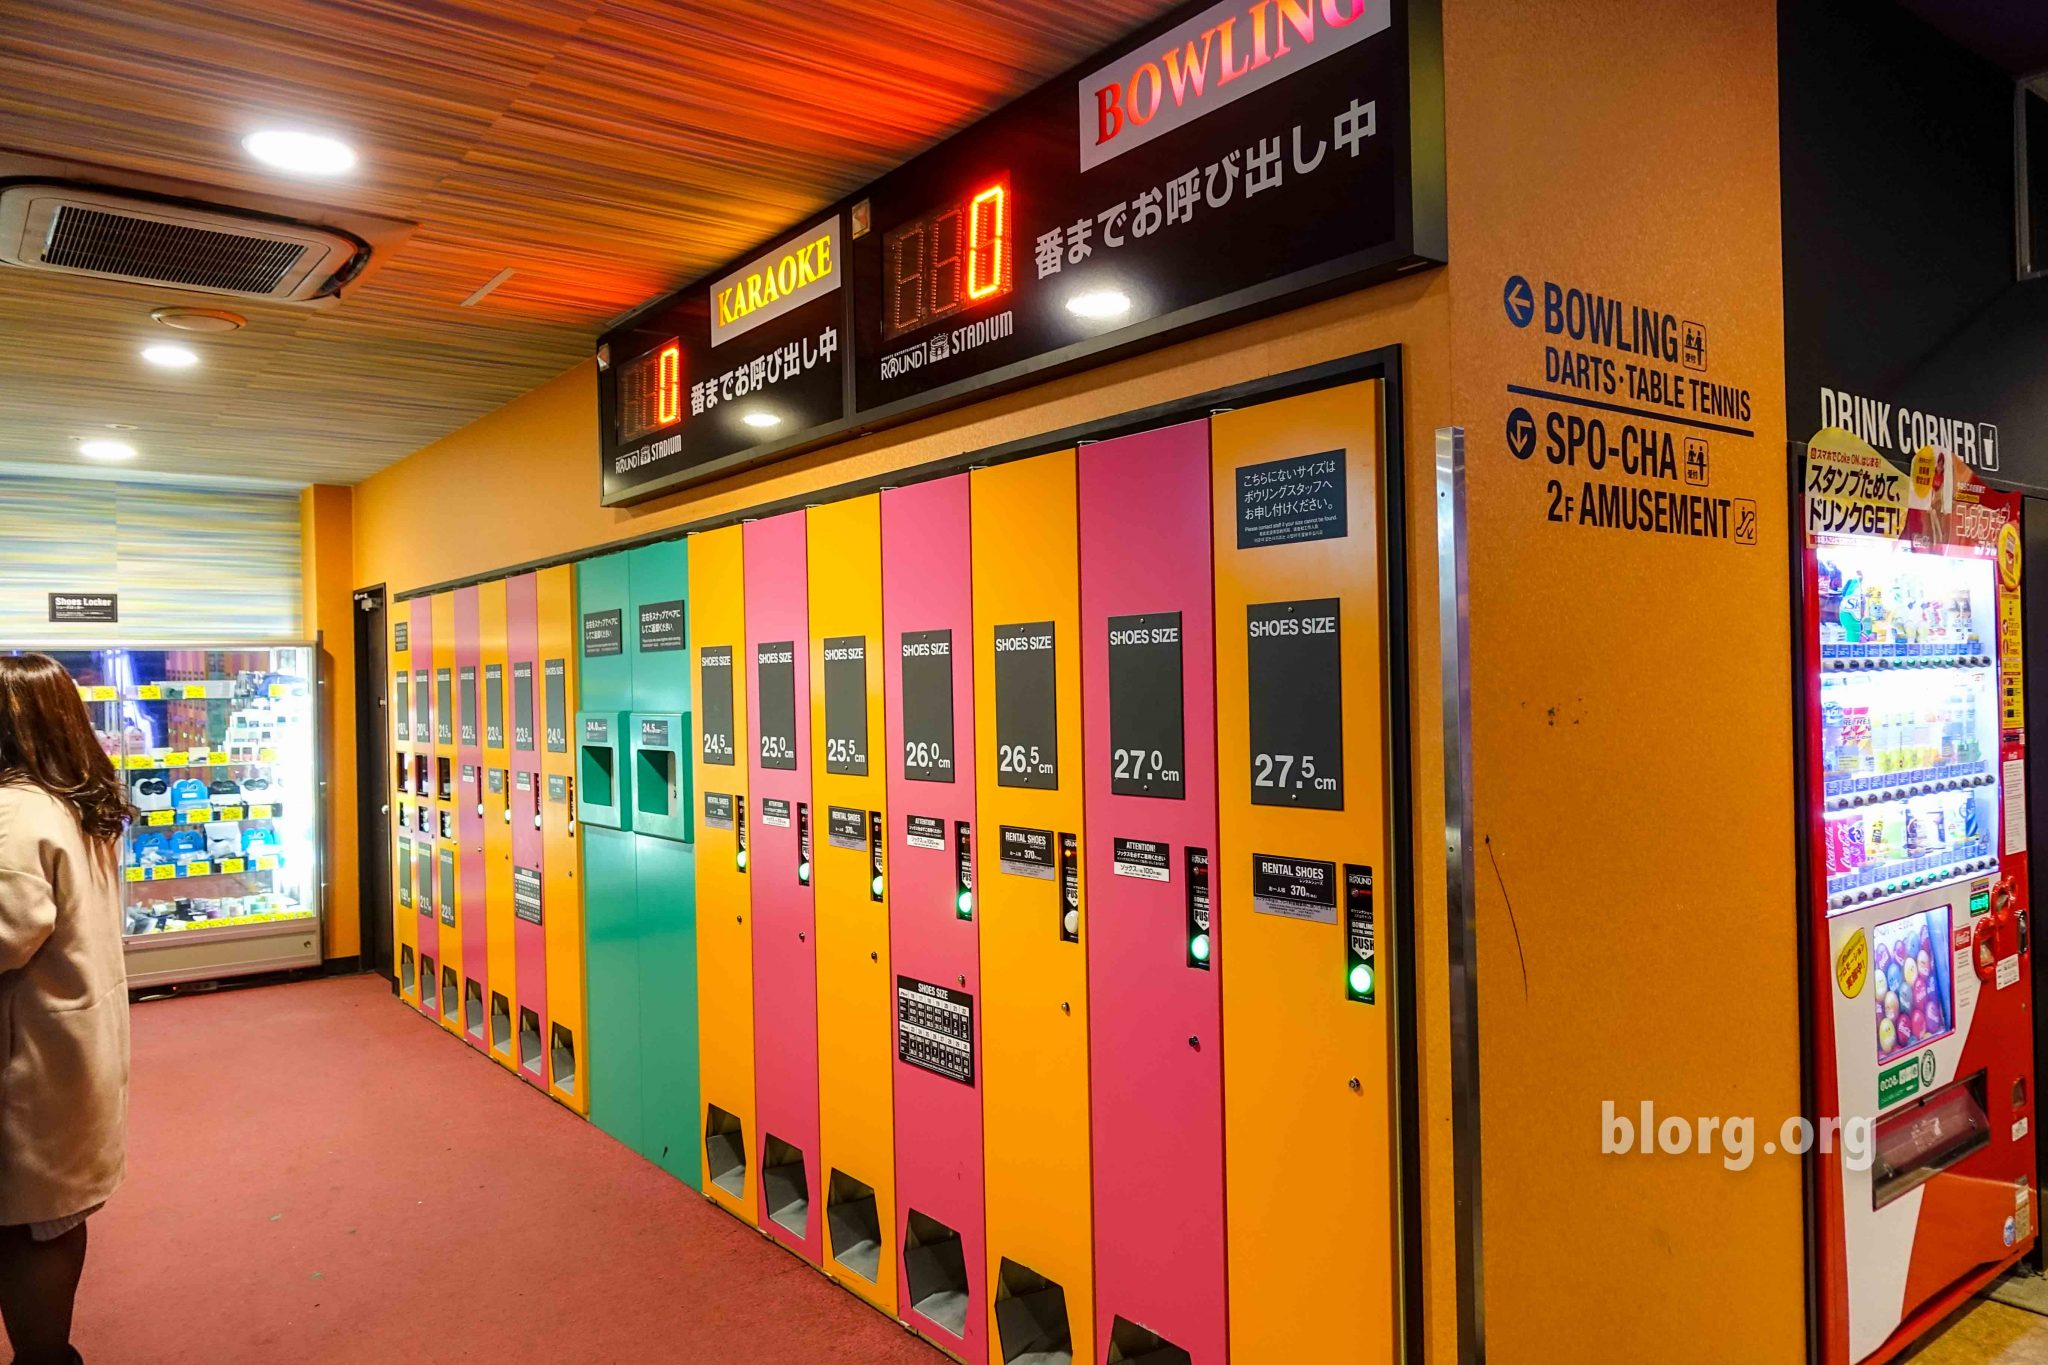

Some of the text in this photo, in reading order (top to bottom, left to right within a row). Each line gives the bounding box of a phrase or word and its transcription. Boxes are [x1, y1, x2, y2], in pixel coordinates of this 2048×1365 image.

[1034, 98, 1377, 280] 番までお呼び出し中
[716, 235, 833, 328] KARAOKE
[951, 310, 1013, 355] STADIUM
[1544, 281, 1679, 364] BOWLING
[690, 326, 838, 417] 番までお呼び出し中
[1689, 379, 1751, 421] TENNIS
[1820, 387, 1978, 466] DRINK CORNER
[651, 434, 682, 462] STADIUM
[1546, 411, 1678, 481] SPO-CHA
[1243, 460, 1336, 487] こちらにないサイズは
[1808, 464, 1900, 502] スタンプためて、
[1244, 480, 1333, 504] ボウリングスタッフへ
[1244, 498, 1333, 520] お申し付けください。
[1547, 480, 1731, 539] 2F AMUSEMENT
[1808, 498, 1900, 536] ドリンクGET!
[55, 597, 112, 607] Shoes Locker
[1110, 628, 1179, 646] SHOES SIZE
[1249, 617, 1336, 637] SHOES SIZE
[824, 647, 864, 661] SHOES SIZE
[902, 642, 949, 657] SHOES SIZE
[996, 636, 1052, 651] SHOES SIZE
[701, 656, 731, 667] SHOES SIZE
[758, 652, 793, 665] SHOES SIZE
[1005, 831, 1047, 846] RENTAL SHOES
[1262, 862, 1324, 880] RENTAL SHOES
[1194, 910, 1208, 922] PUS
[917, 982, 949, 1000] SHOES SIZE
